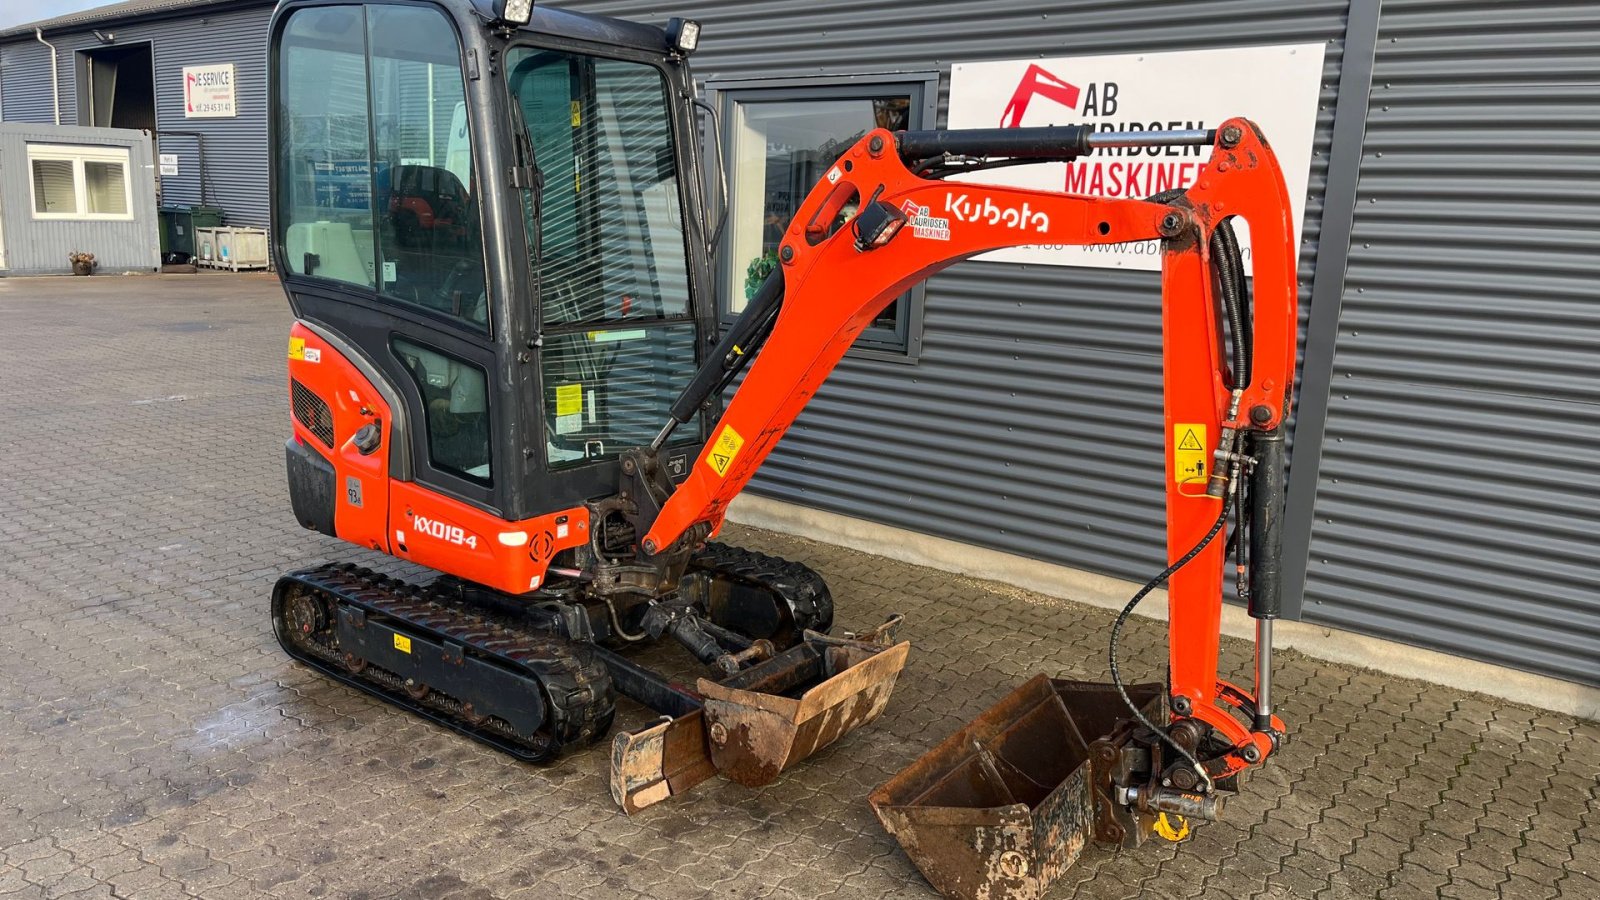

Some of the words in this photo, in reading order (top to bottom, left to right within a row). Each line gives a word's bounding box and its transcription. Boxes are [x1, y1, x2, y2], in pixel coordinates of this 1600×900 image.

[203, 71, 229, 86] SERVICE
[1082, 82, 1119, 117] AB
[919, 207, 929, 217] AB
[945, 192, 1049, 233] Kubota
[910, 216, 948, 230] LAURIDSEN
[914, 227, 950, 240] MASKINER
